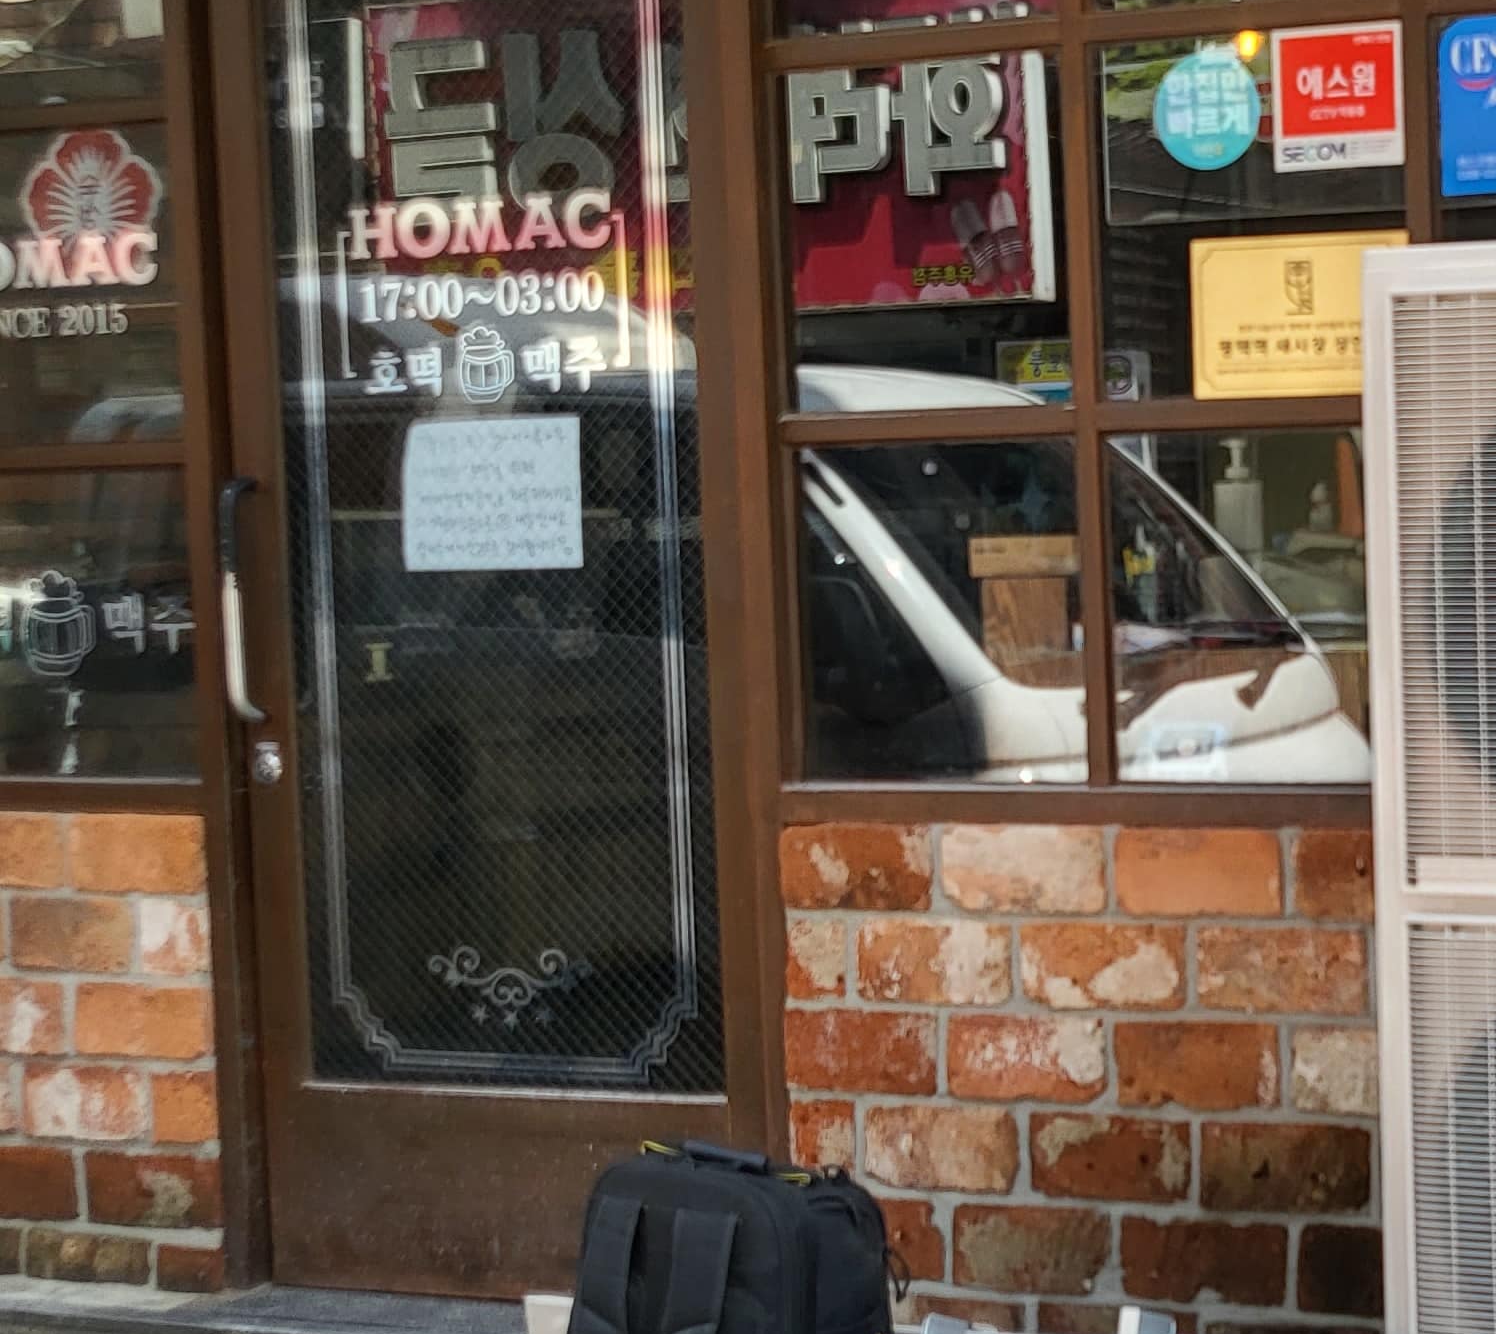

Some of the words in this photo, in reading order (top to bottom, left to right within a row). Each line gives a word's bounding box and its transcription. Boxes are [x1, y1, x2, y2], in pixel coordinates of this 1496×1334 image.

[1296, 61, 1376, 100] 에스원
[1283, 142, 1347, 164] SECOM
[349, 188, 612, 260] HOMAC
[59, 303, 129, 336] 2015
[359, 267, 606, 324] 17:00~03:00
[363, 345, 443, 397] 호떡
[520, 335, 607, 394] 맥주
[102, 592, 198, 655] 맥주
